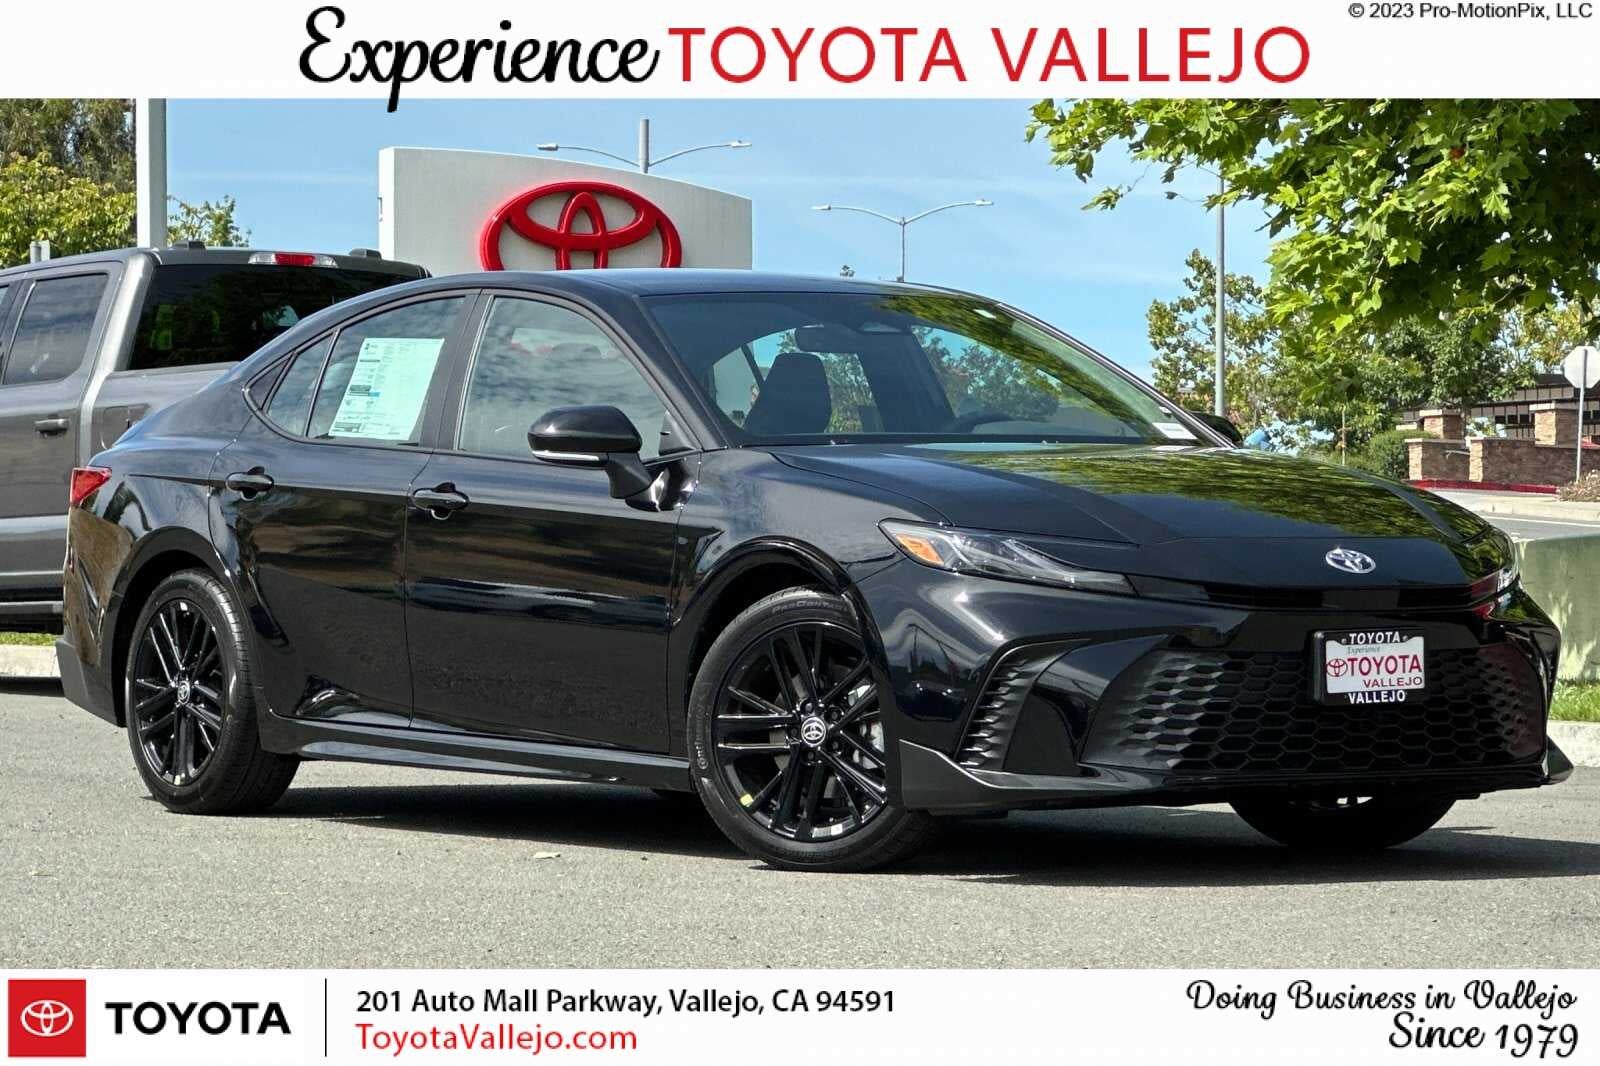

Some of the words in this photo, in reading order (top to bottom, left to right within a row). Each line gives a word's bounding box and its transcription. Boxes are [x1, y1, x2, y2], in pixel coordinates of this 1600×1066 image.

[1349, 631, 1400, 644] TOYOTA
[1347, 655, 1422, 676] TOYOTA
[1363, 677, 1422, 688] VALLEJO
[1348, 690, 1405, 704] VALLEJO
